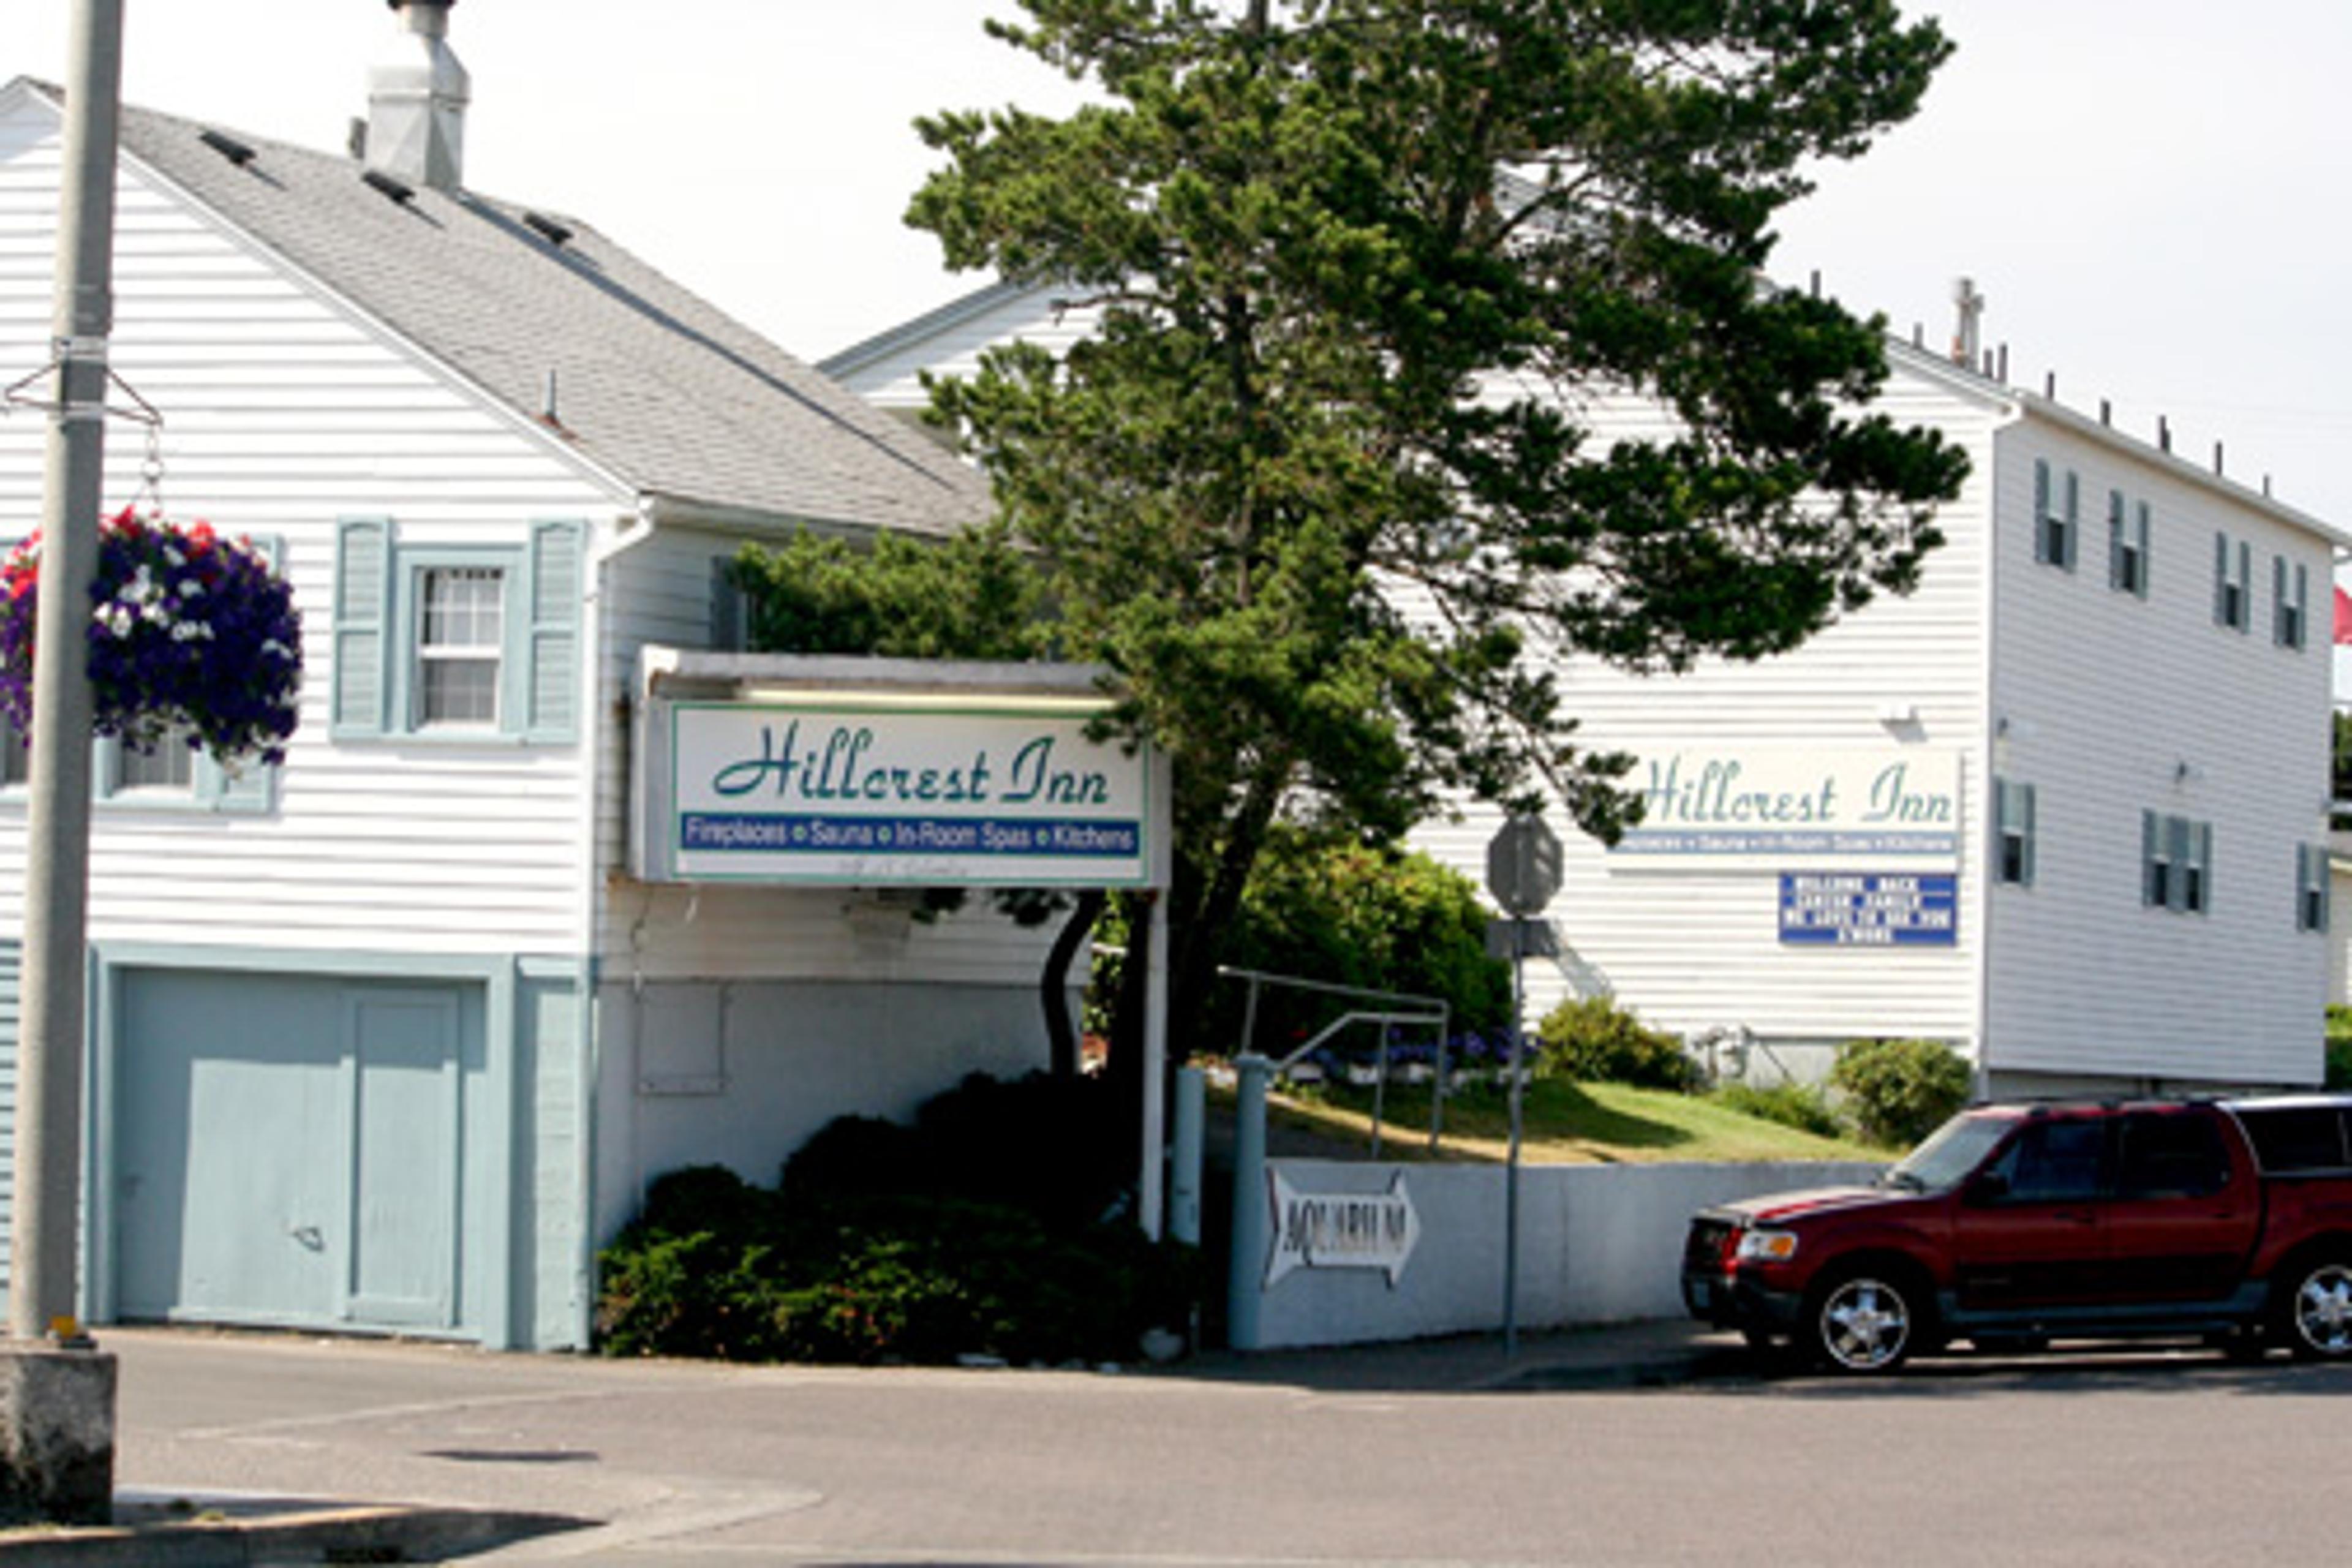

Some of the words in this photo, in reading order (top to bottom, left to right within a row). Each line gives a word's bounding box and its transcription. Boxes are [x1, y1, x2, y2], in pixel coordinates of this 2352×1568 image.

[712, 718, 991, 800] Hillcrest
[999, 736, 1109, 804] Inn
[1642, 755, 1838, 822] Hillcrest
[1860, 761, 1953, 822] Inn
[685, 816, 786, 848] Fireplaces
[811, 819, 873, 846] Sauna
[895, 821, 976, 846] In-Room
[982, 823, 1031, 850] Spas
[1054, 825, 1134, 850] Kitchens
[1283, 1199, 1406, 1267] AQUARIUM
